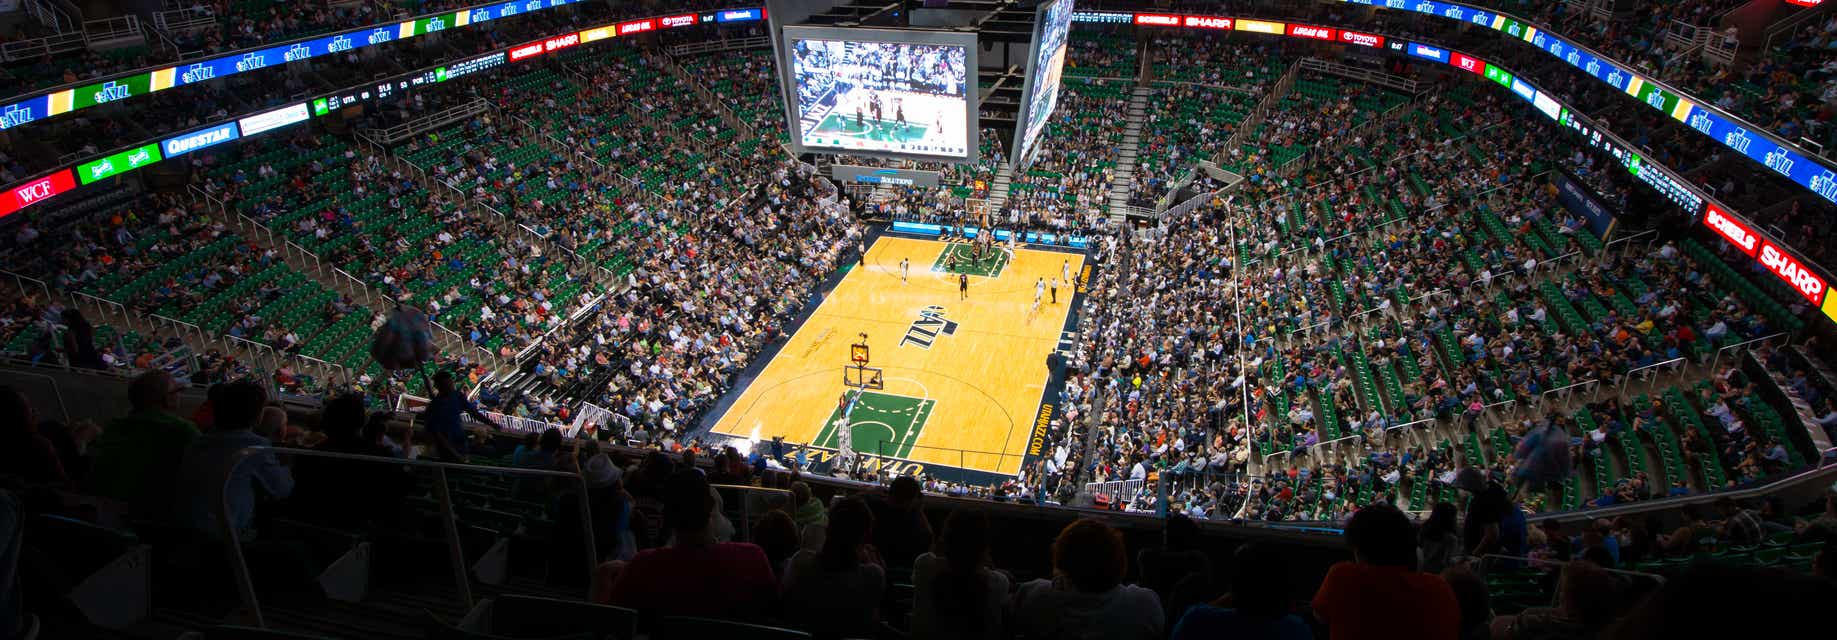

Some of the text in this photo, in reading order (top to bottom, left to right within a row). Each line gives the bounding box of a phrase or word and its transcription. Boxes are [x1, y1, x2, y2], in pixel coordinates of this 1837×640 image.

[1185, 17, 1231, 28] SHARP
[1293, 27, 1316, 37] LUCAS
[1353, 34, 1377, 44] TOYOTA
[546, 34, 578, 51] SHARP
[167, 127, 232, 154] QUESTAR
[18, 180, 51, 203] WCF
[1760, 245, 1822, 298] SHARP
